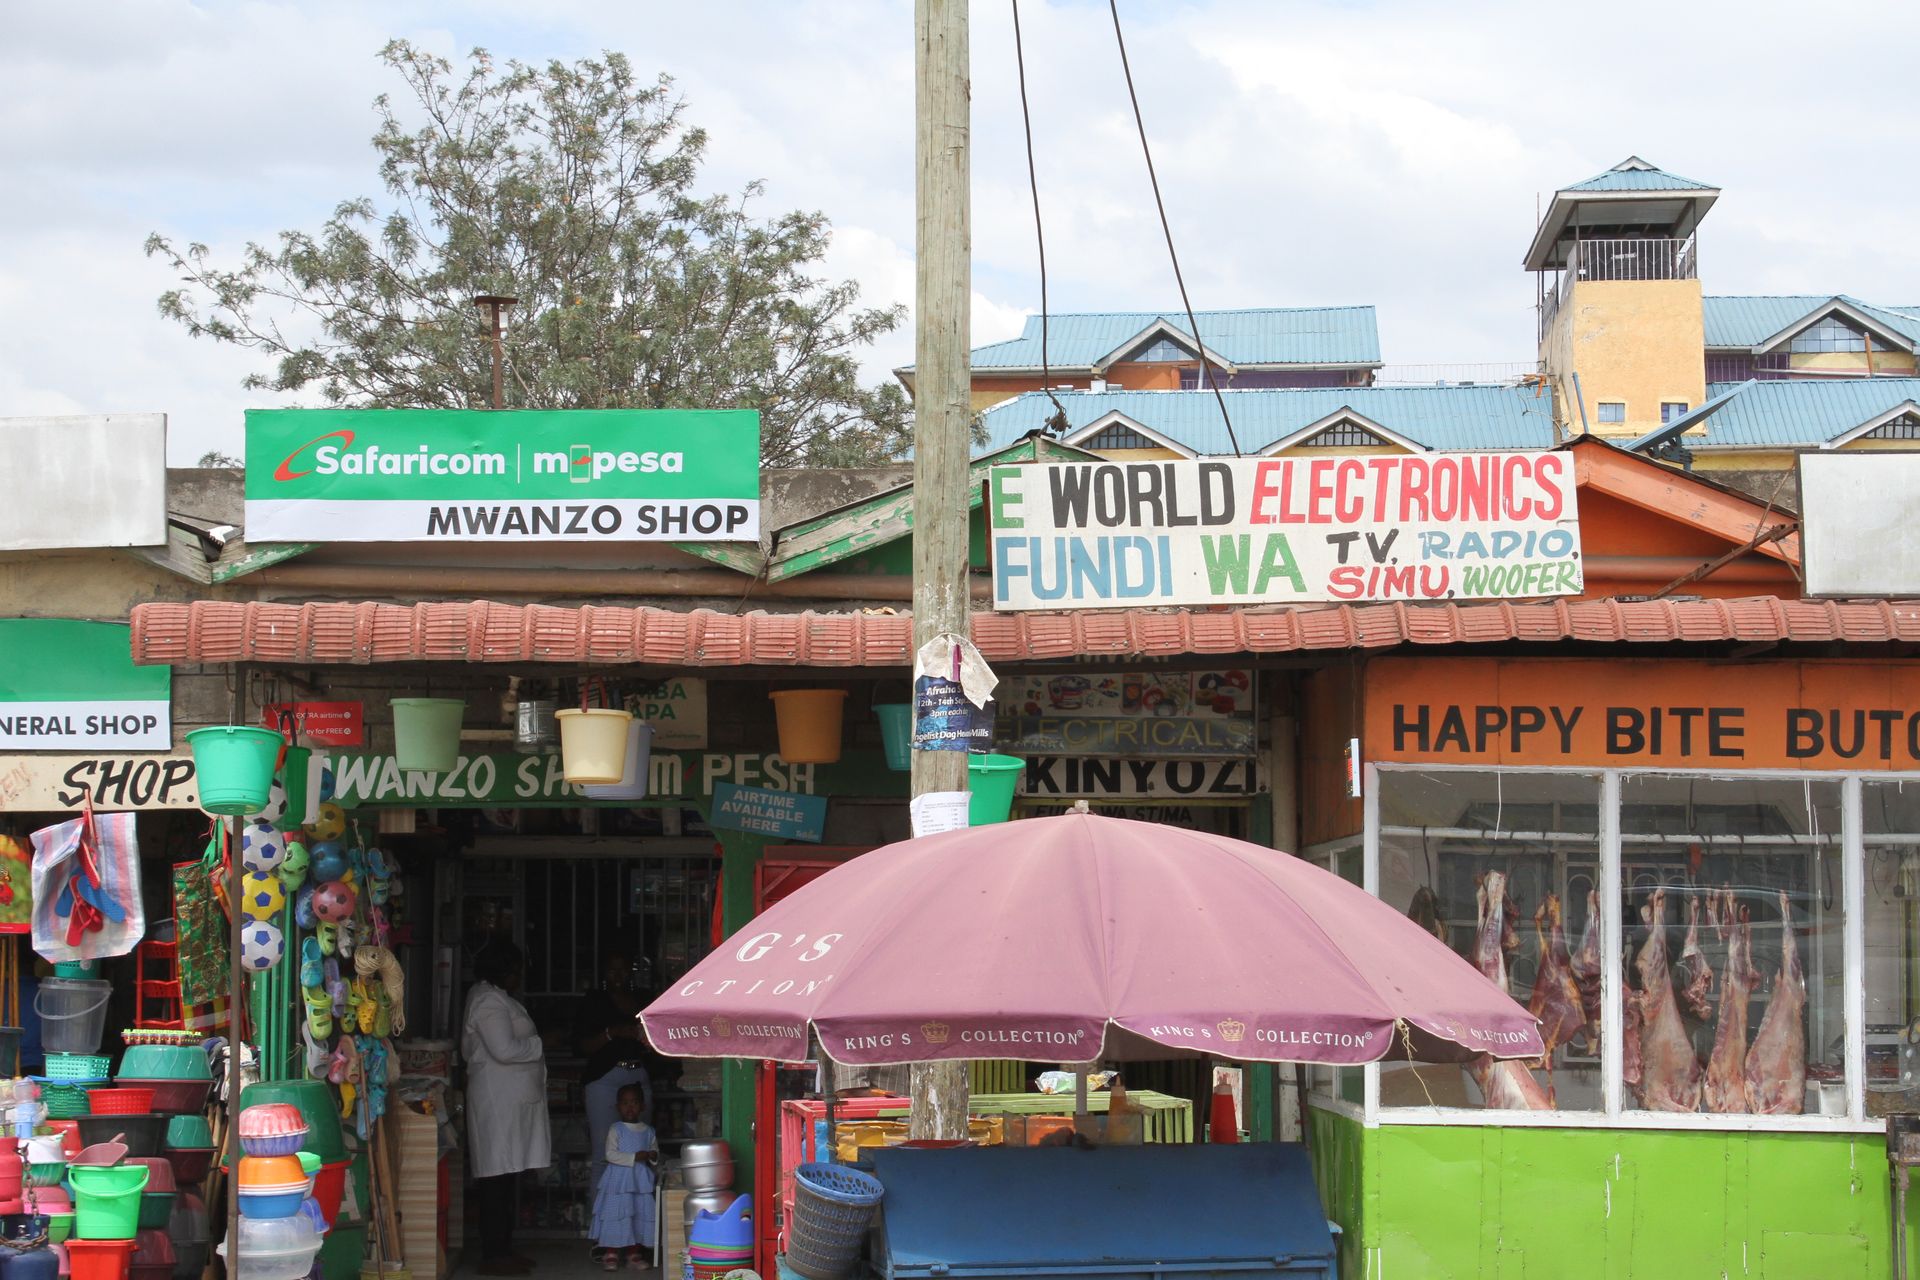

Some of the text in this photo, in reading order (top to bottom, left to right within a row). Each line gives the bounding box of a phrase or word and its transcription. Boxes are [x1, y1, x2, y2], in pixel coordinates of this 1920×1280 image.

[315, 444, 506, 475] Safaricom
[992, 455, 1563, 529] E WORLD ELECTRONICS
[427, 504, 749, 535] MWANZO SHOP
[995, 533, 1308, 601] FUNDI WA
[85, 714, 157, 736] SHOP
[1393, 704, 1584, 754] HAPPY
[1605, 706, 1745, 759] BITE
[1025, 756, 1258, 794] KINYOZI
[720, 800, 805, 823] AVAILABLE
[732, 789, 796, 809] AIRTIME
[740, 816, 781, 832] HERE
